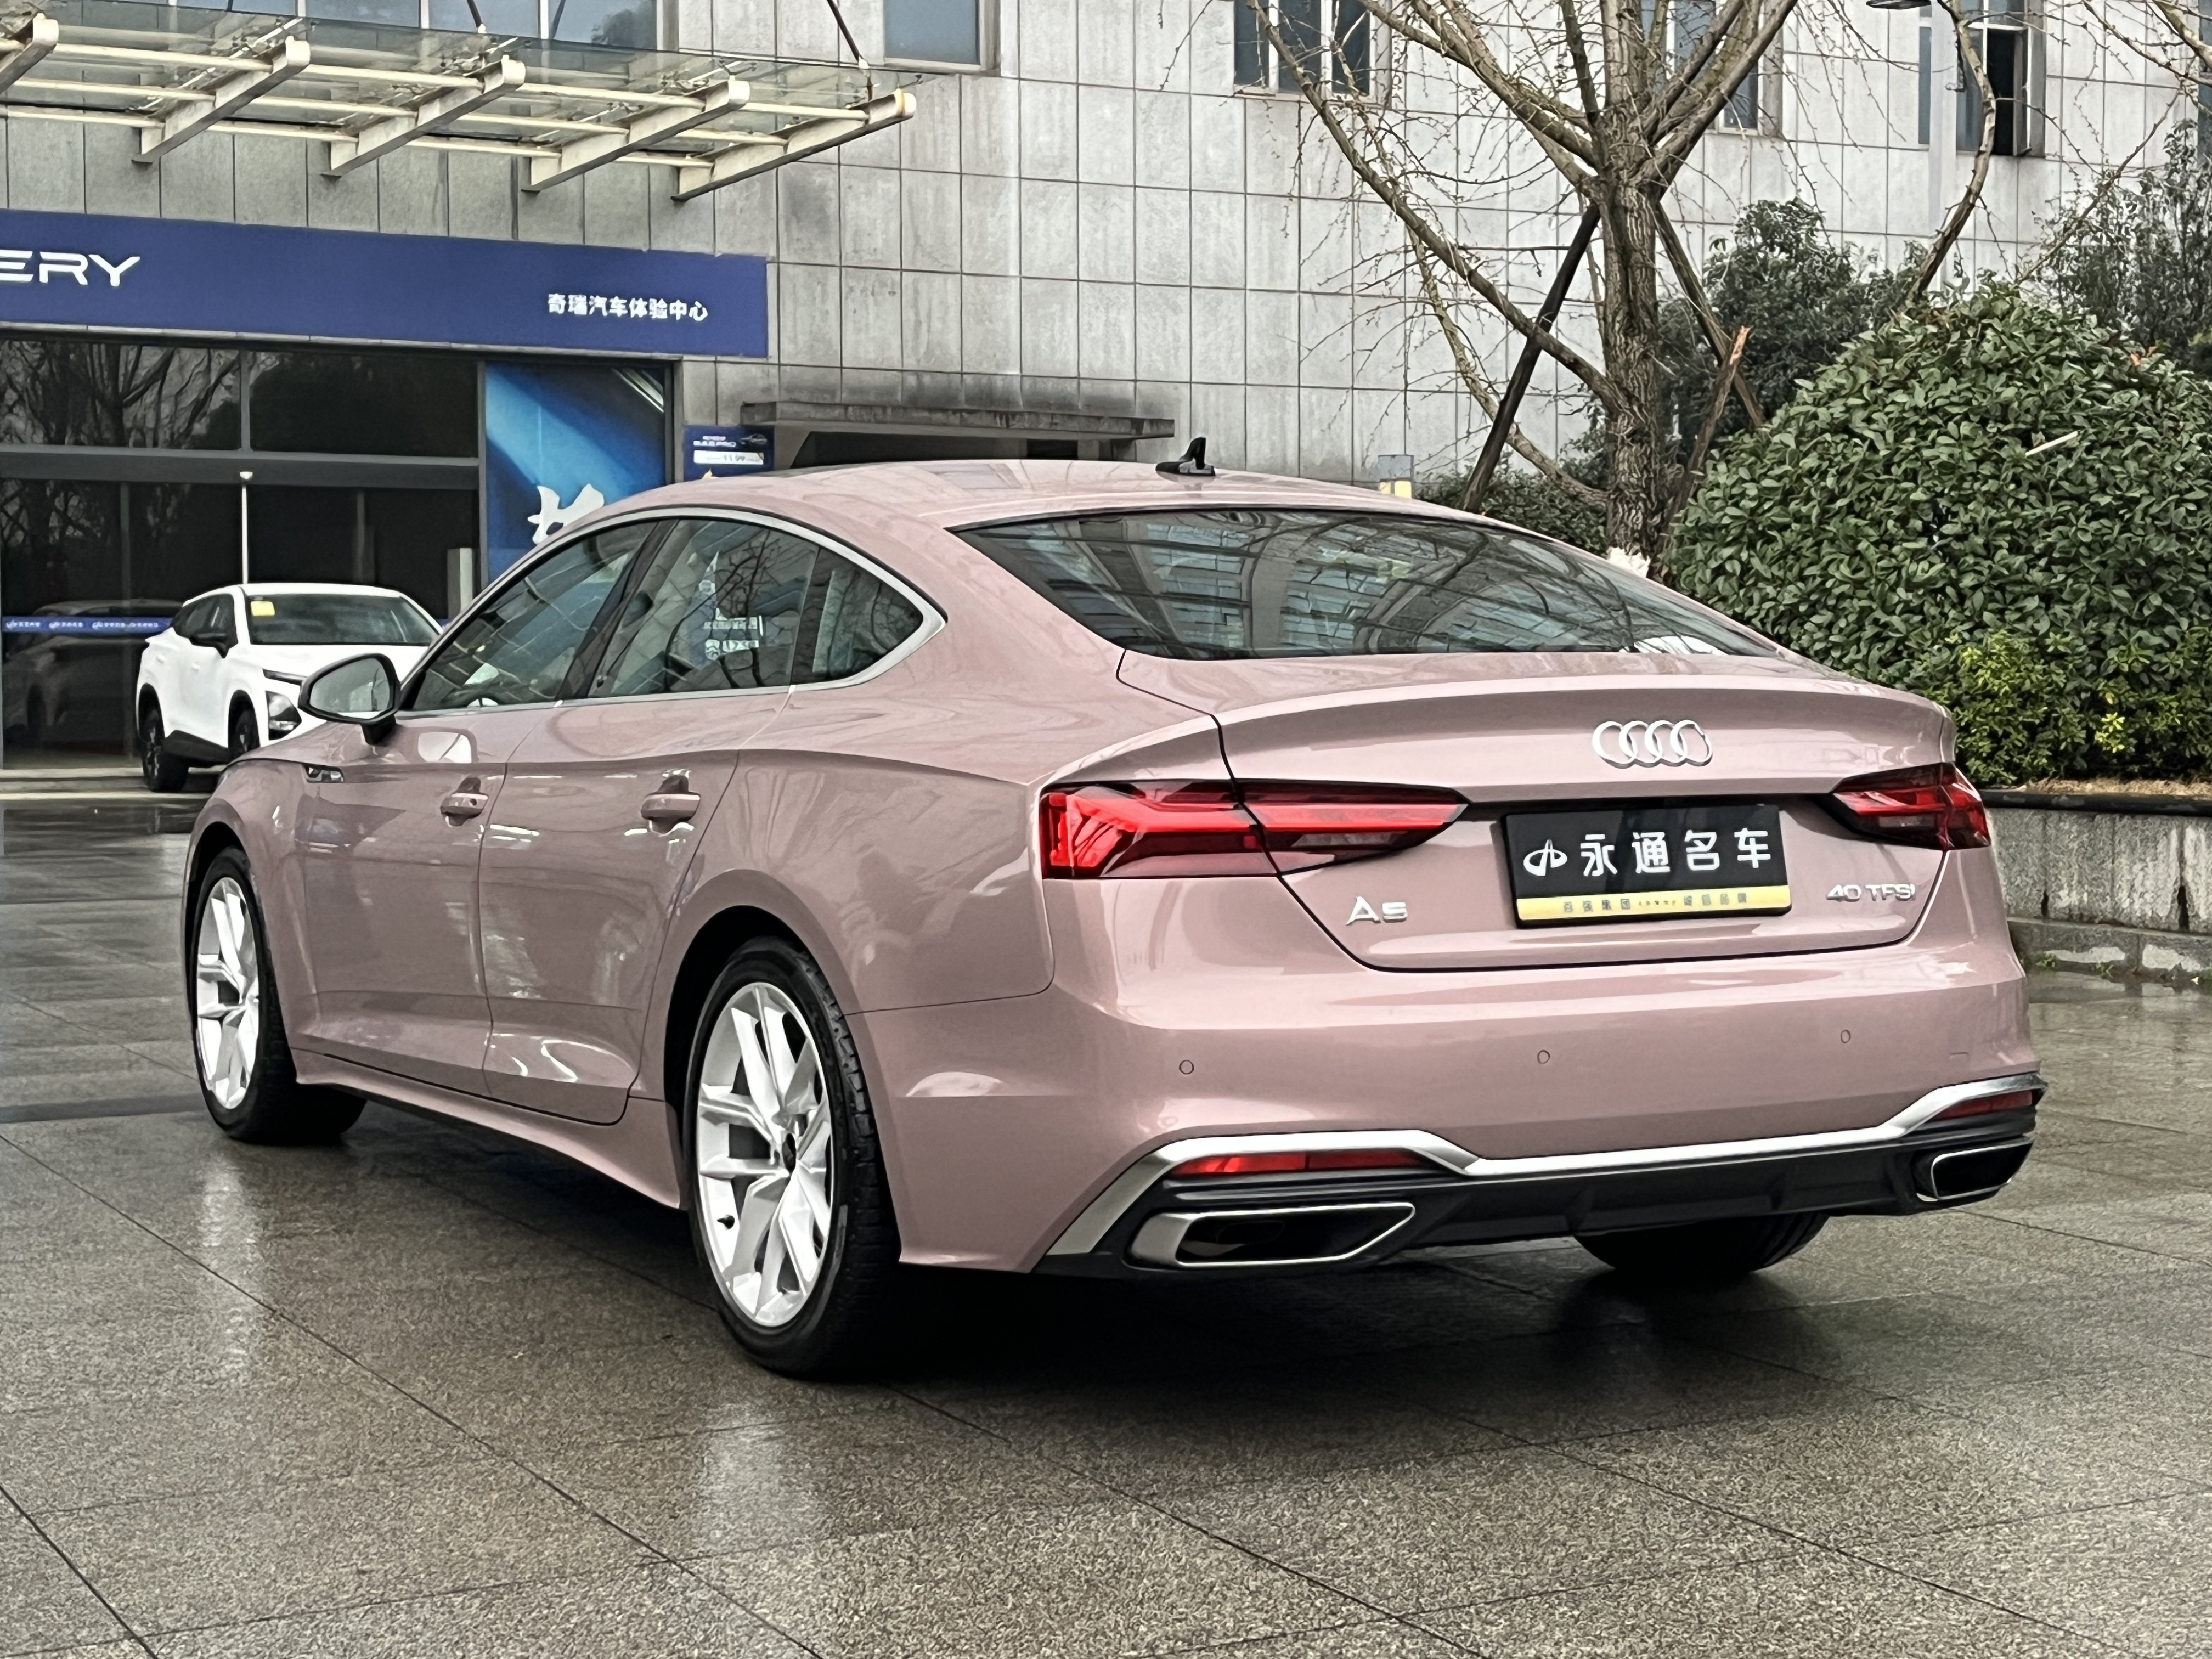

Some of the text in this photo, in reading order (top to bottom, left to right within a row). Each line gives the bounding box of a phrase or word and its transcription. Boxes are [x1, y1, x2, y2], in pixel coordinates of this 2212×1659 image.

[548, 293, 708, 321] 奇瑞汽车体验中心
[1579, 827, 1771, 877] 永通名车
[1826, 883, 1916, 902] 40 TFSI
[1346, 896, 1408, 926] A5
